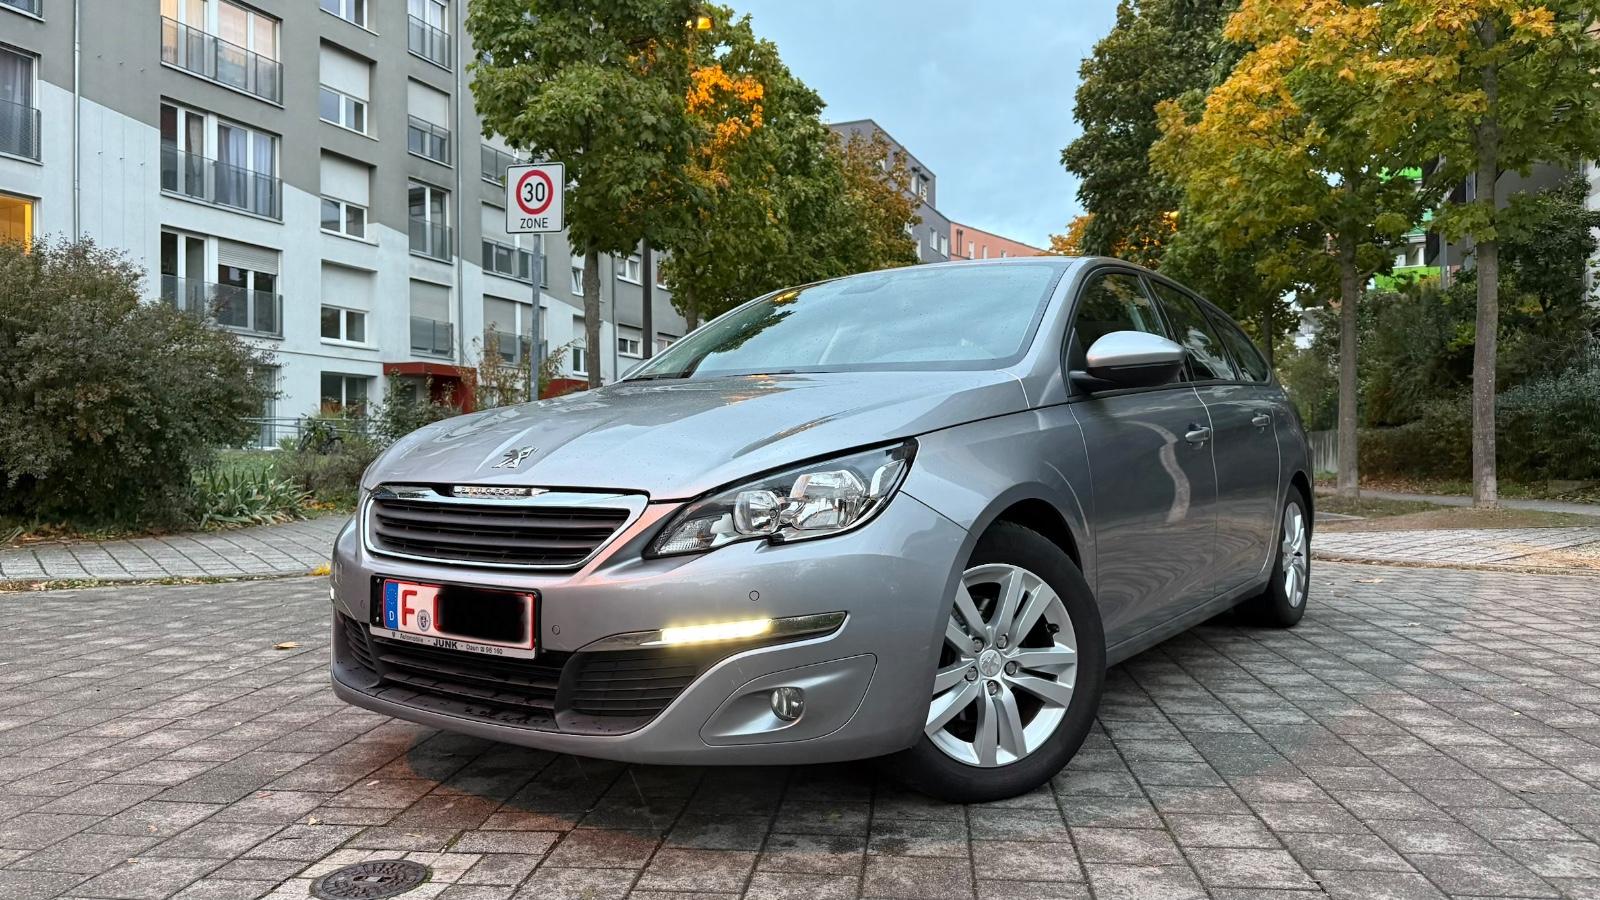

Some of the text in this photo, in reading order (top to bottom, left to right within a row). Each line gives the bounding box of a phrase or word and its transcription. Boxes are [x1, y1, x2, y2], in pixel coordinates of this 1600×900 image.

[524, 182, 545, 202] 30
[520, 217, 549, 229] ZONE
[389, 610, 395, 621] D
[433, 638, 458, 650] JUNK
